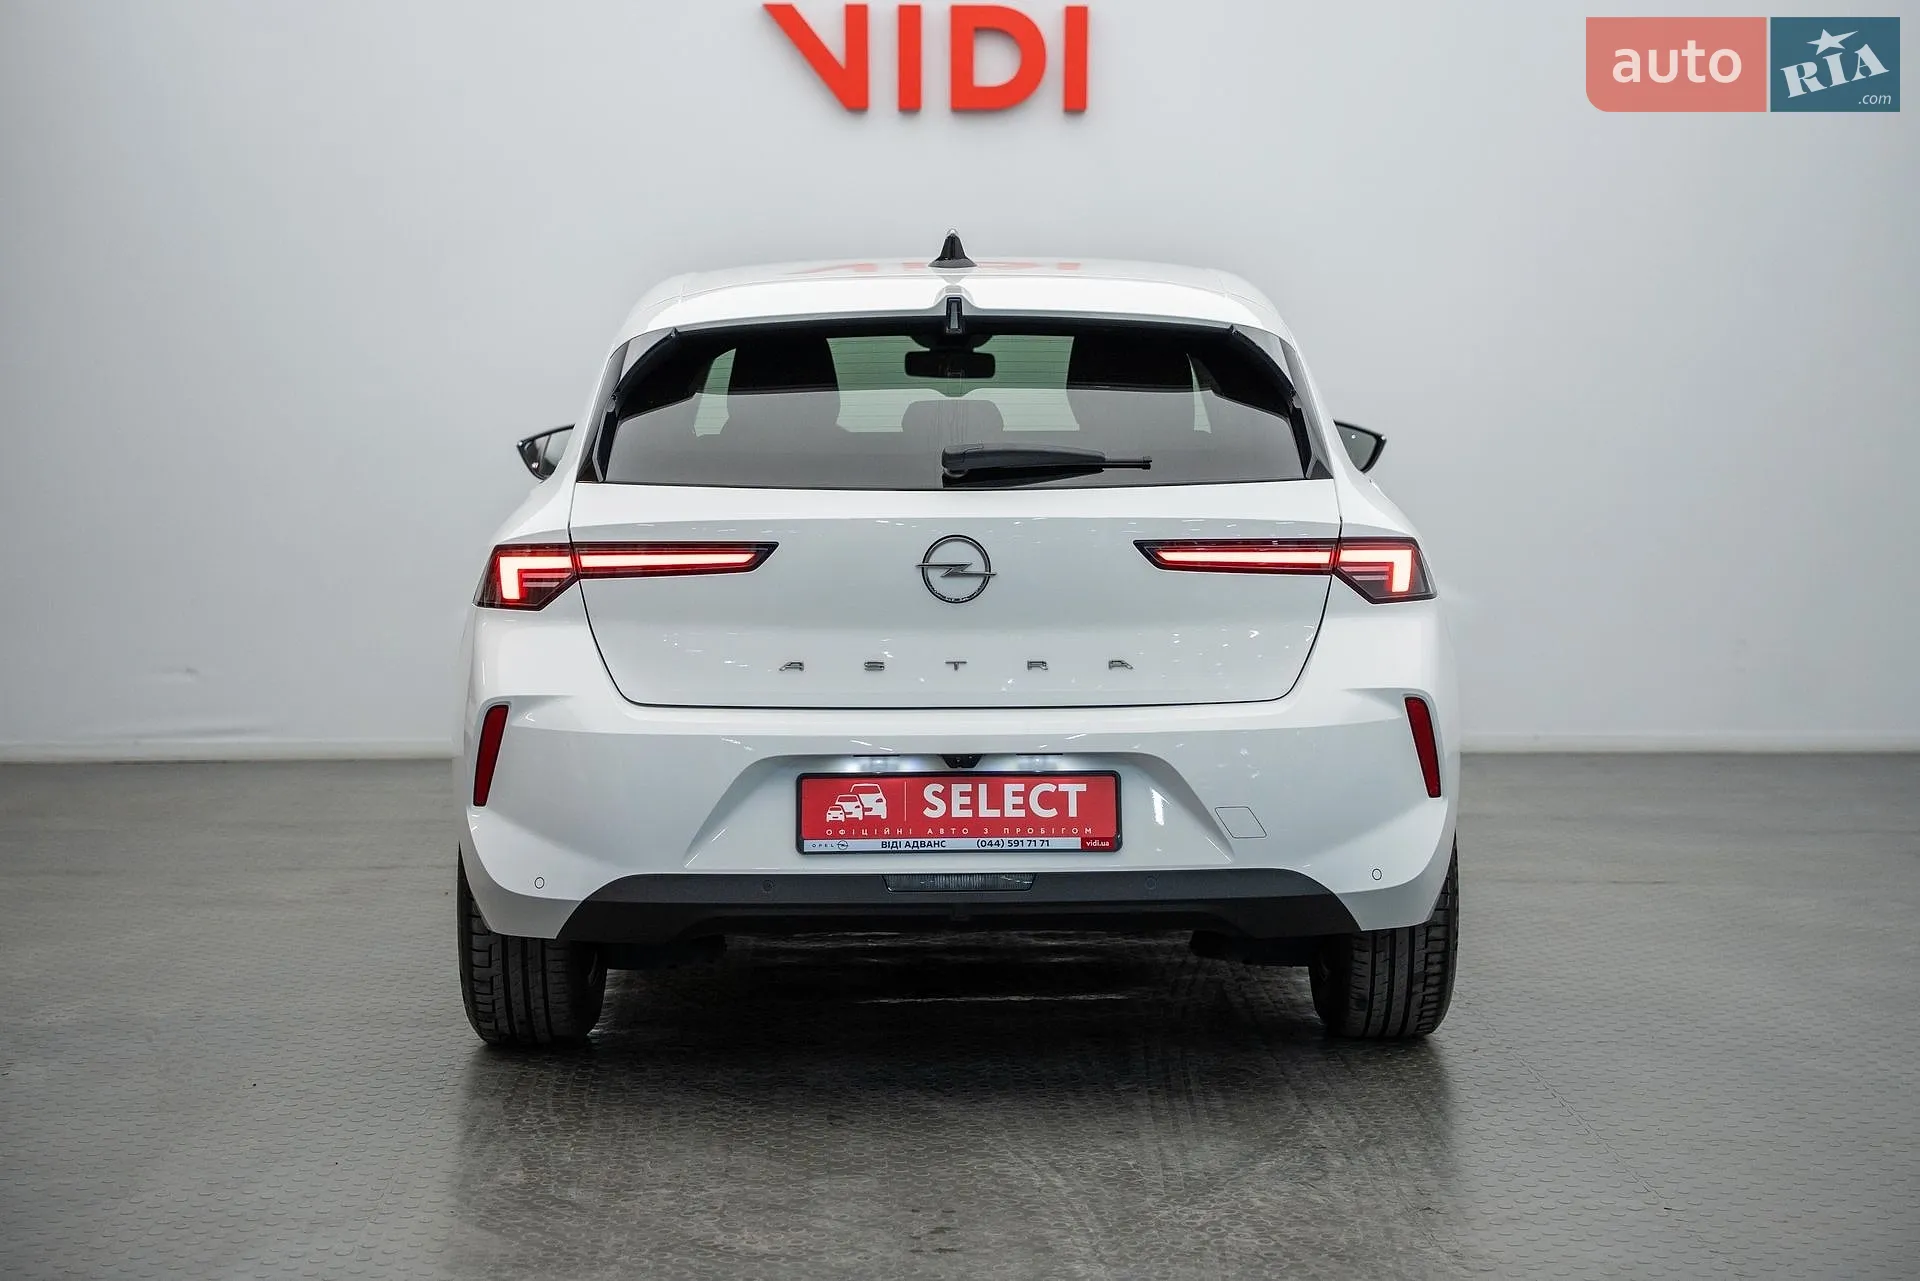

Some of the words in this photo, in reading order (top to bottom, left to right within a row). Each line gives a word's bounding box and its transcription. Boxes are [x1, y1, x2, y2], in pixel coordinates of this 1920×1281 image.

[763, 4, 1088, 112] VIDI
[779, 660, 1134, 671] ASTRA
[922, 783, 1087, 818] SELECT
[825, 828, 912, 836] ОФІЦІЙНІ
[881, 840, 902, 849] ВІДІ
[904, 839, 947, 849] АДВАНС
[976, 839, 1005, 848] (044)
[1007, 839, 1024, 847] 591
[1027, 839, 1037, 847] 71
[1039, 839, 1050, 847] 71
